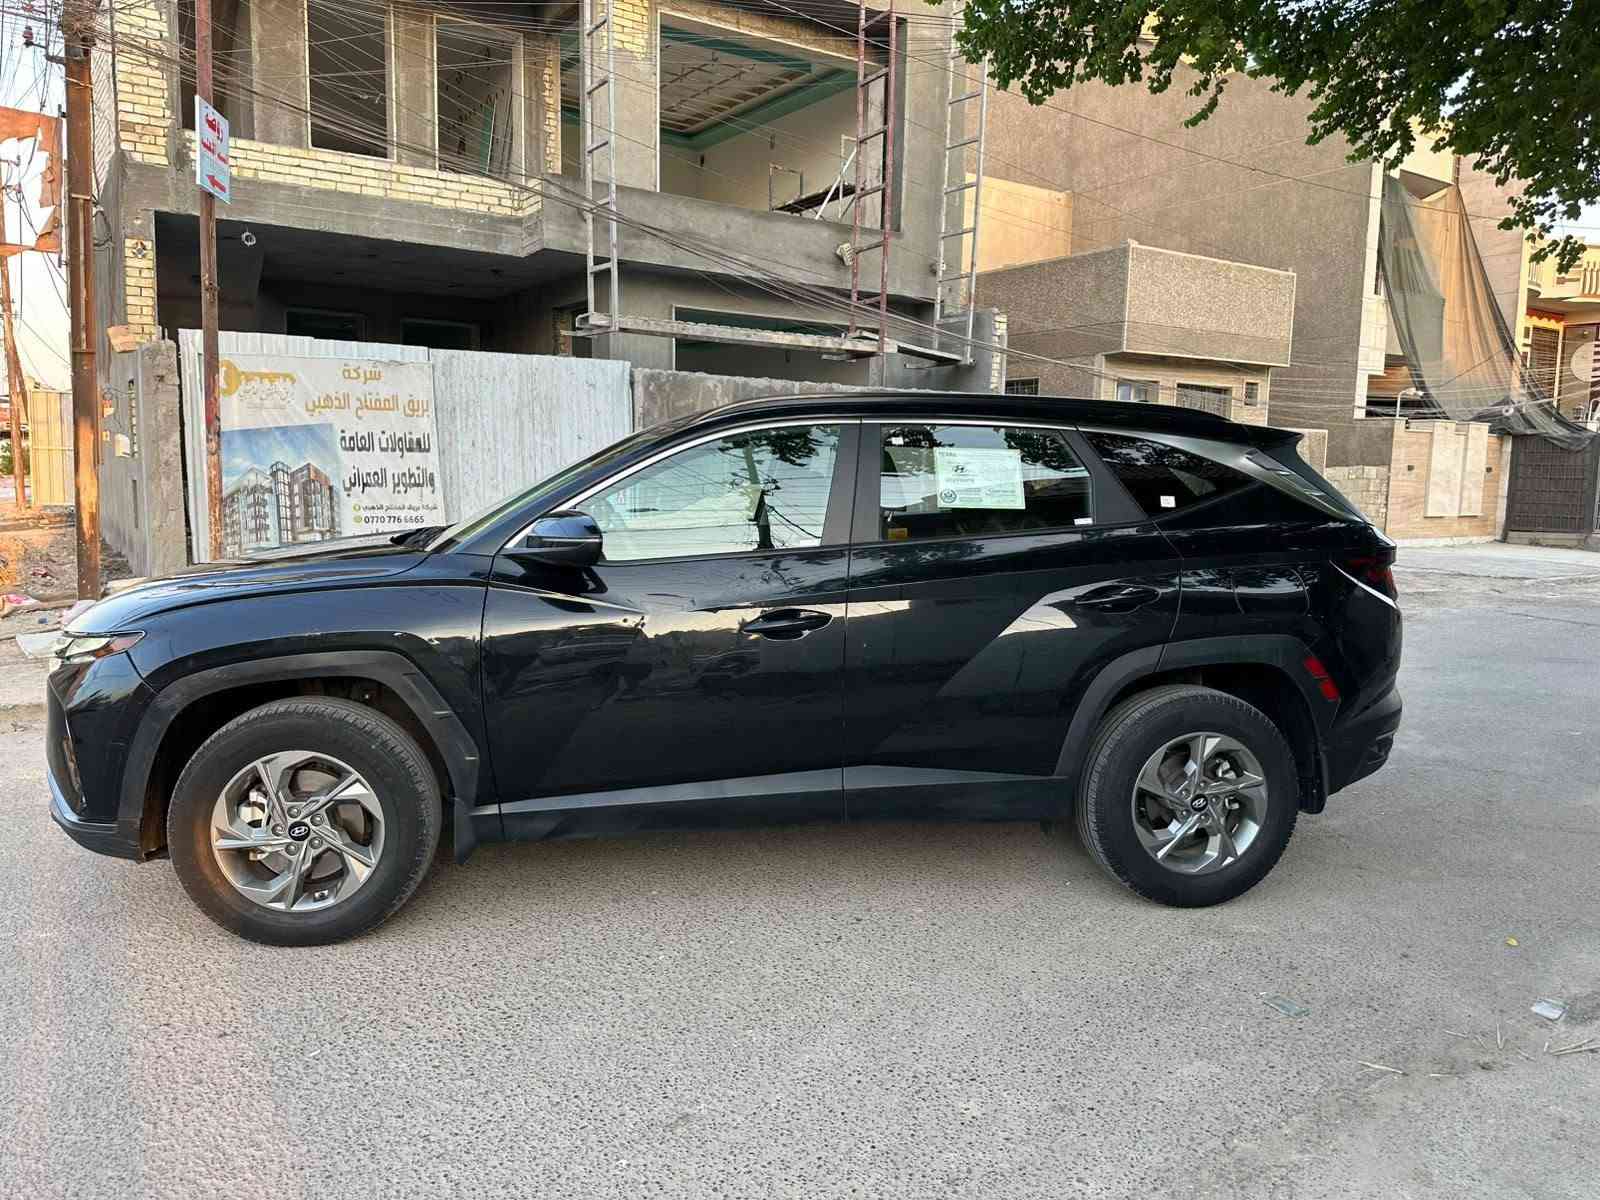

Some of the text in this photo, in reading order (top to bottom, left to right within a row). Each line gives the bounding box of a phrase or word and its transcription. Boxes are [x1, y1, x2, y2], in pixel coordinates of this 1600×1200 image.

[342, 363, 382, 384] شركة
[304, 391, 351, 417] الذهبي
[355, 392, 400, 420] المفتاح
[402, 398, 430, 418] بريق
[340, 429, 431, 459] للمقاولات العامة
[342, 464, 435, 497] والتطوير العمراني
[364, 515, 385, 524] 0770
[386, 515, 402, 523] 776
